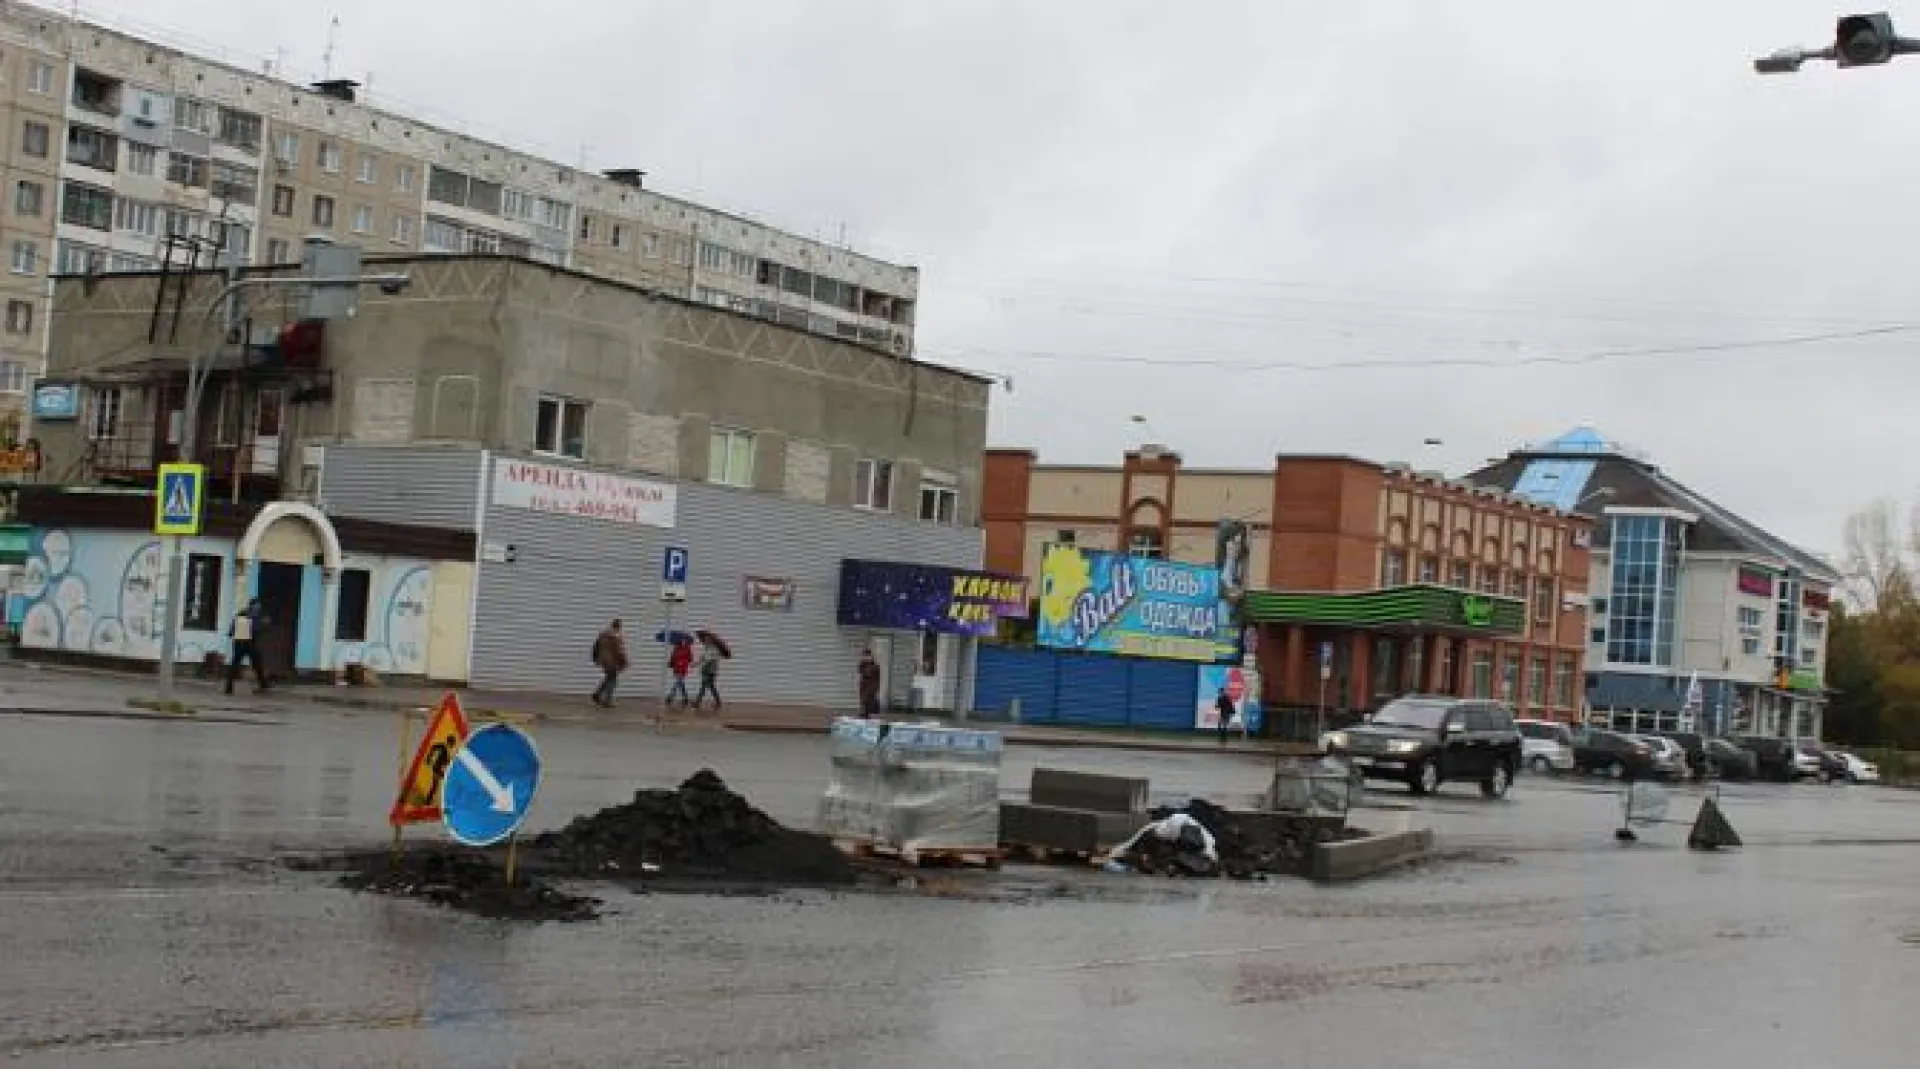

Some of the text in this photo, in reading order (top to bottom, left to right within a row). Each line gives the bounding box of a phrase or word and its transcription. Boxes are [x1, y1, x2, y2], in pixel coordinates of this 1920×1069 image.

[504, 463, 588, 491] АРЕНДА
[1143, 566, 1199, 597] ОБУВЬ
[1140, 601, 1216, 636] ОДЕЖДА
